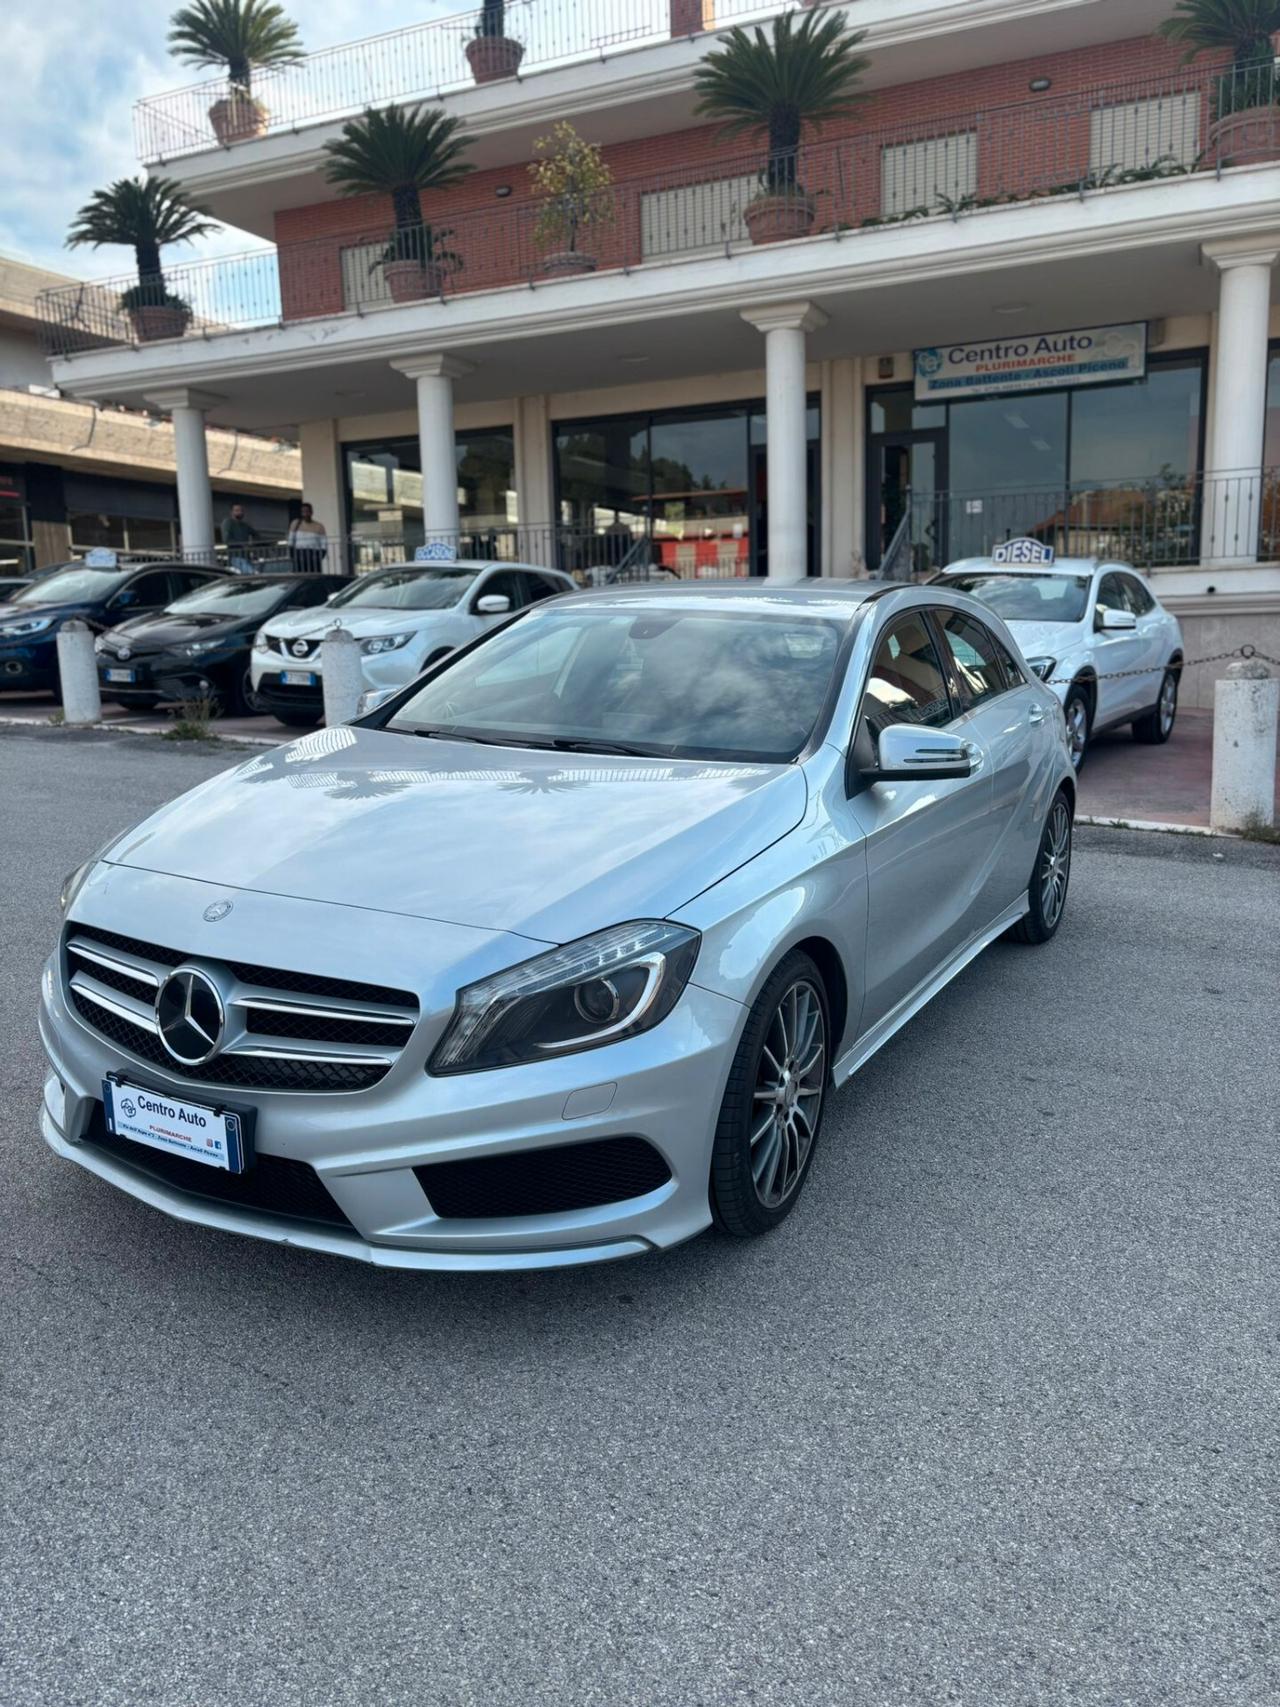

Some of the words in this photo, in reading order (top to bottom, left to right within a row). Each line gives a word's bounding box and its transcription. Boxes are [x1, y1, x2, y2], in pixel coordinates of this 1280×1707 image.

[948, 343, 1028, 364] Centro
[1034, 335, 1093, 354] Auto
[975, 354, 1076, 372] PLURIMARCHE
[994, 541, 1048, 563] DIESEL
[137, 1095, 176, 1118] Centro
[178, 1108, 207, 1127] Auto
[149, 1125, 192, 1142] PLURIMARCHE
